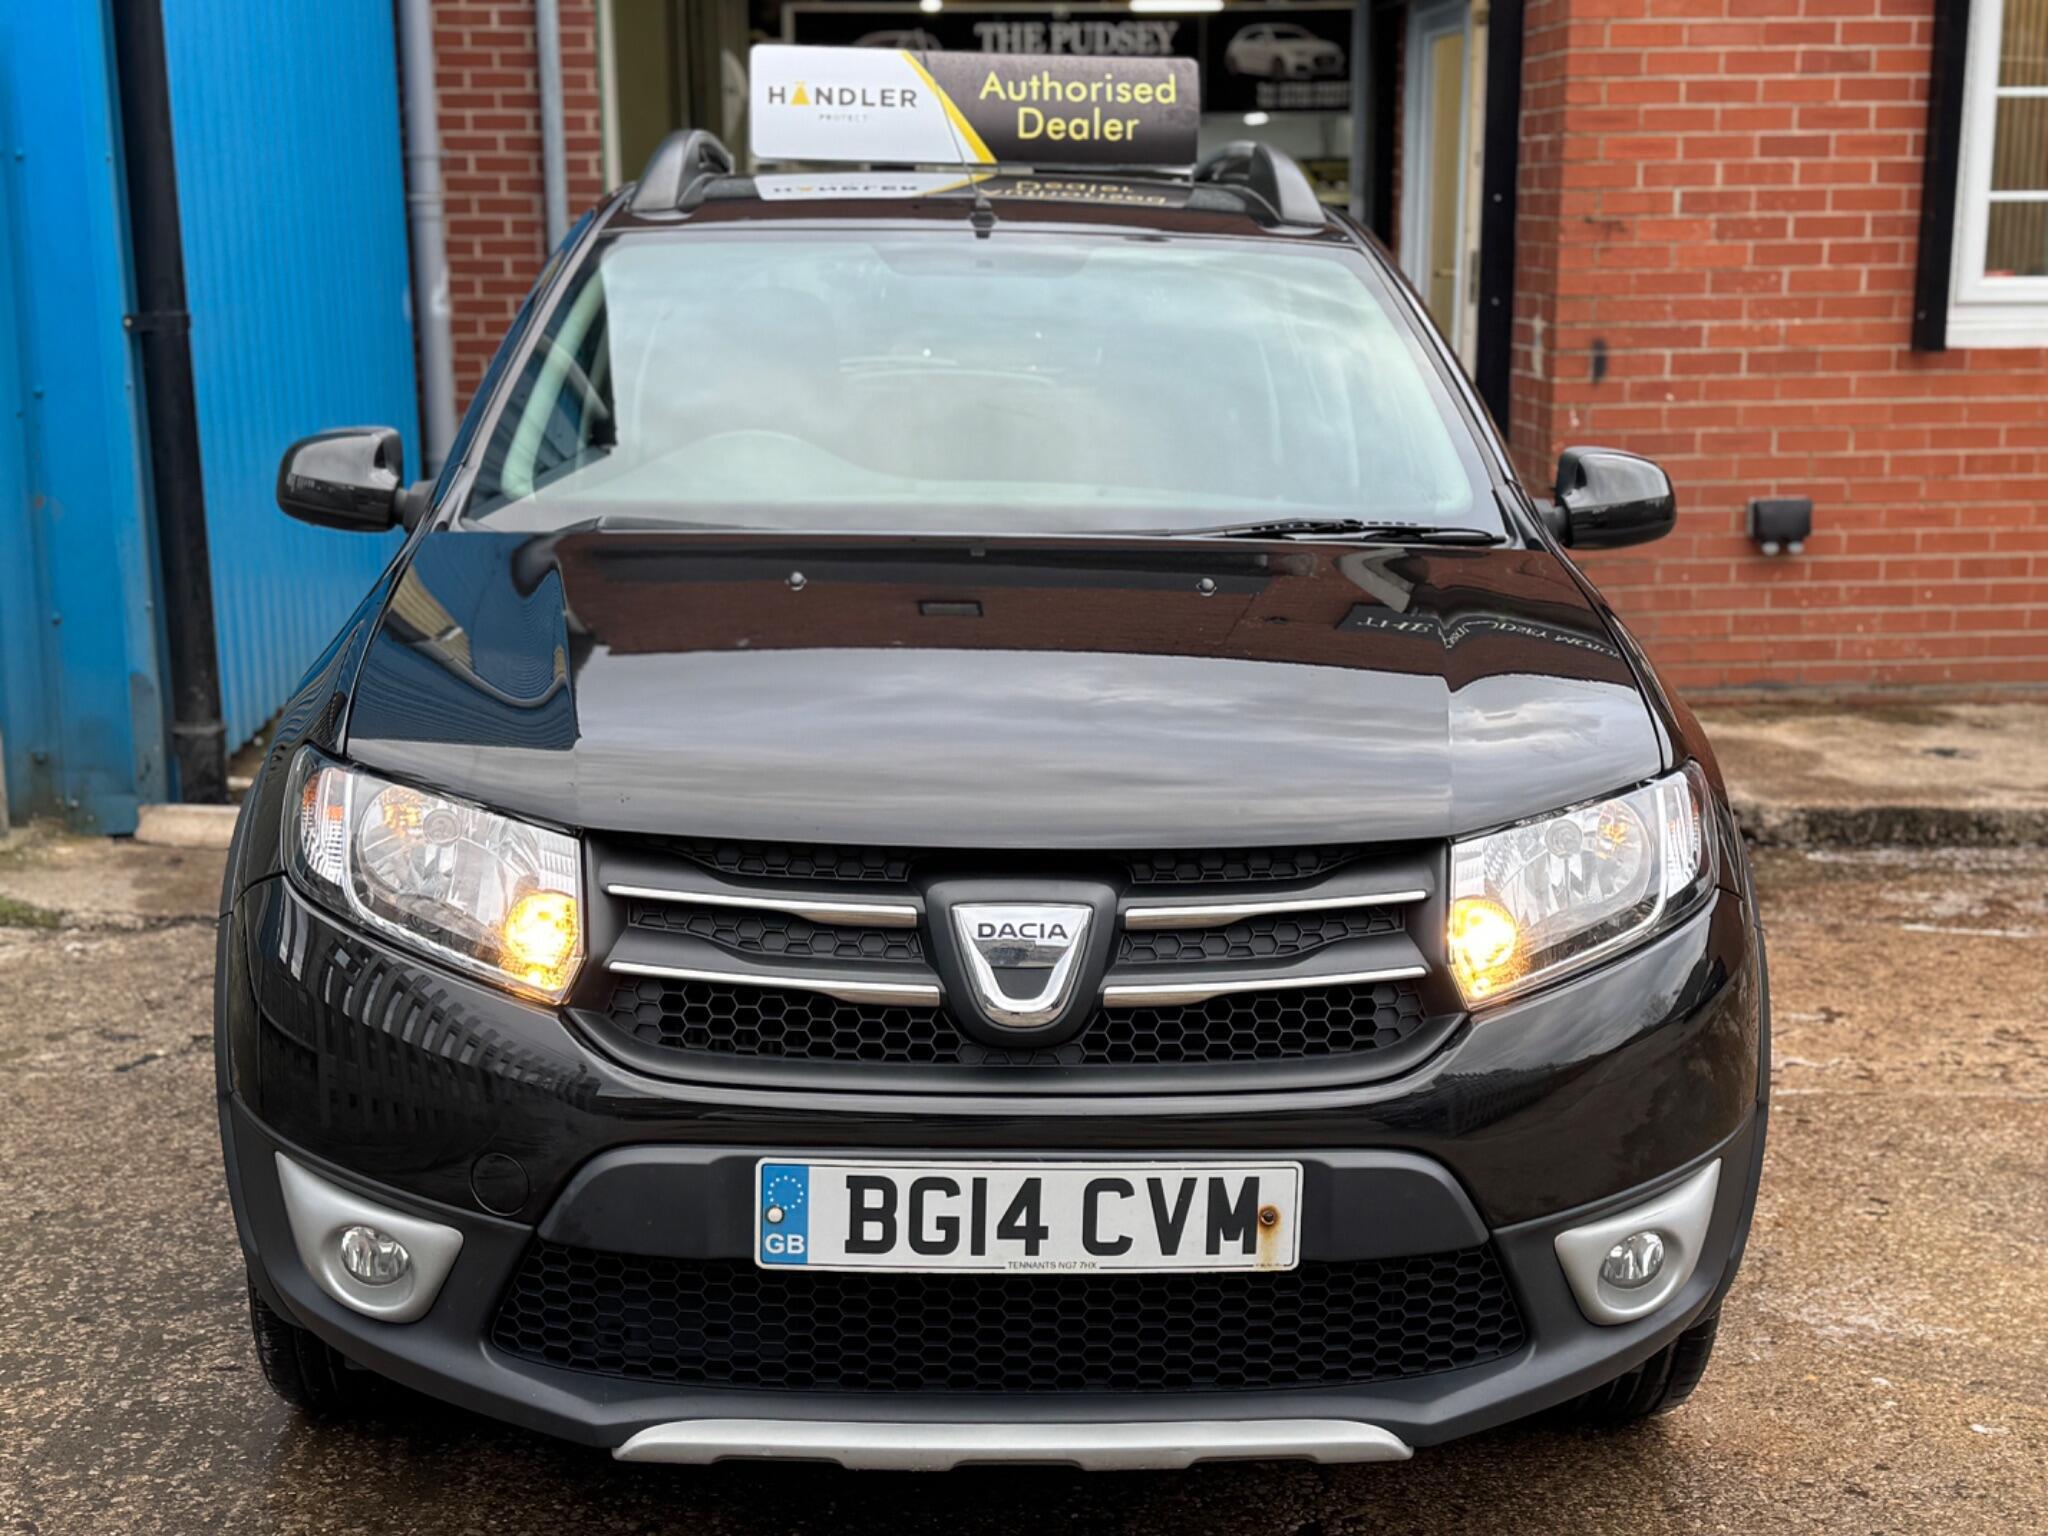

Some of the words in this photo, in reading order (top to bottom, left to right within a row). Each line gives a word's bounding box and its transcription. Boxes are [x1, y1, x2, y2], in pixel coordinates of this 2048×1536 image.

[973, 21, 1046, 54] THE
[1050, 21, 1179, 55] PUDSEY
[979, 71, 1177, 103] Authorised
[1018, 107, 1140, 140] Dealer
[977, 922, 1069, 939] DACIA
[844, 1175, 1049, 1257] BG14
[1082, 1176, 1260, 1257] CVM
[764, 1233, 805, 1254] GB
[1008, 1261, 1057, 1270] TENNANTS
